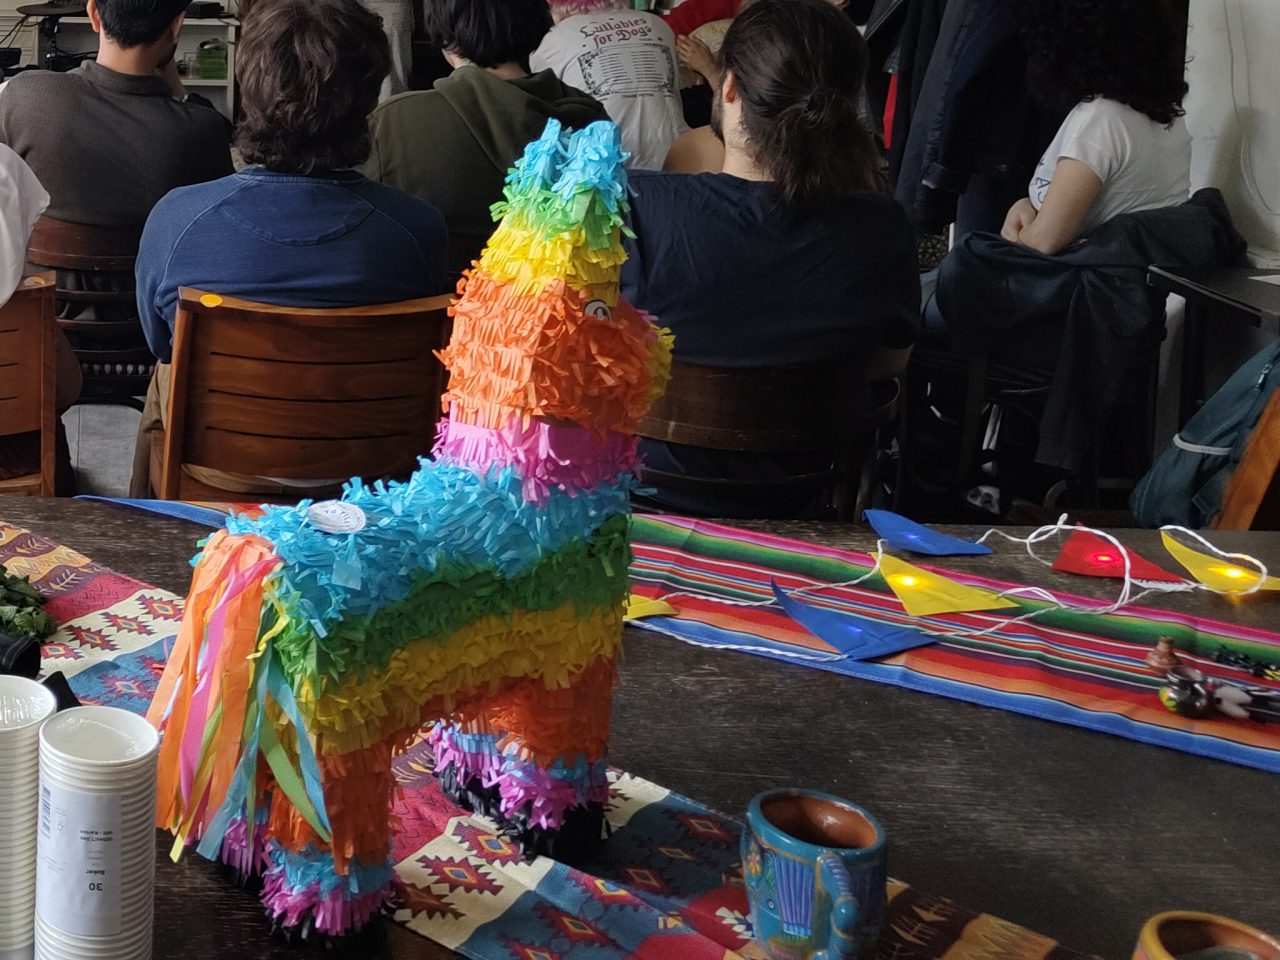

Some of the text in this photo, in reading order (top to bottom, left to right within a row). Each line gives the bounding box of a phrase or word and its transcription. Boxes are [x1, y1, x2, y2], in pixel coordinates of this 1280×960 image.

[580, 18, 647, 38] Lullabies
[593, 27, 652, 48] for Dogs
[88, 882, 103, 891] 30
